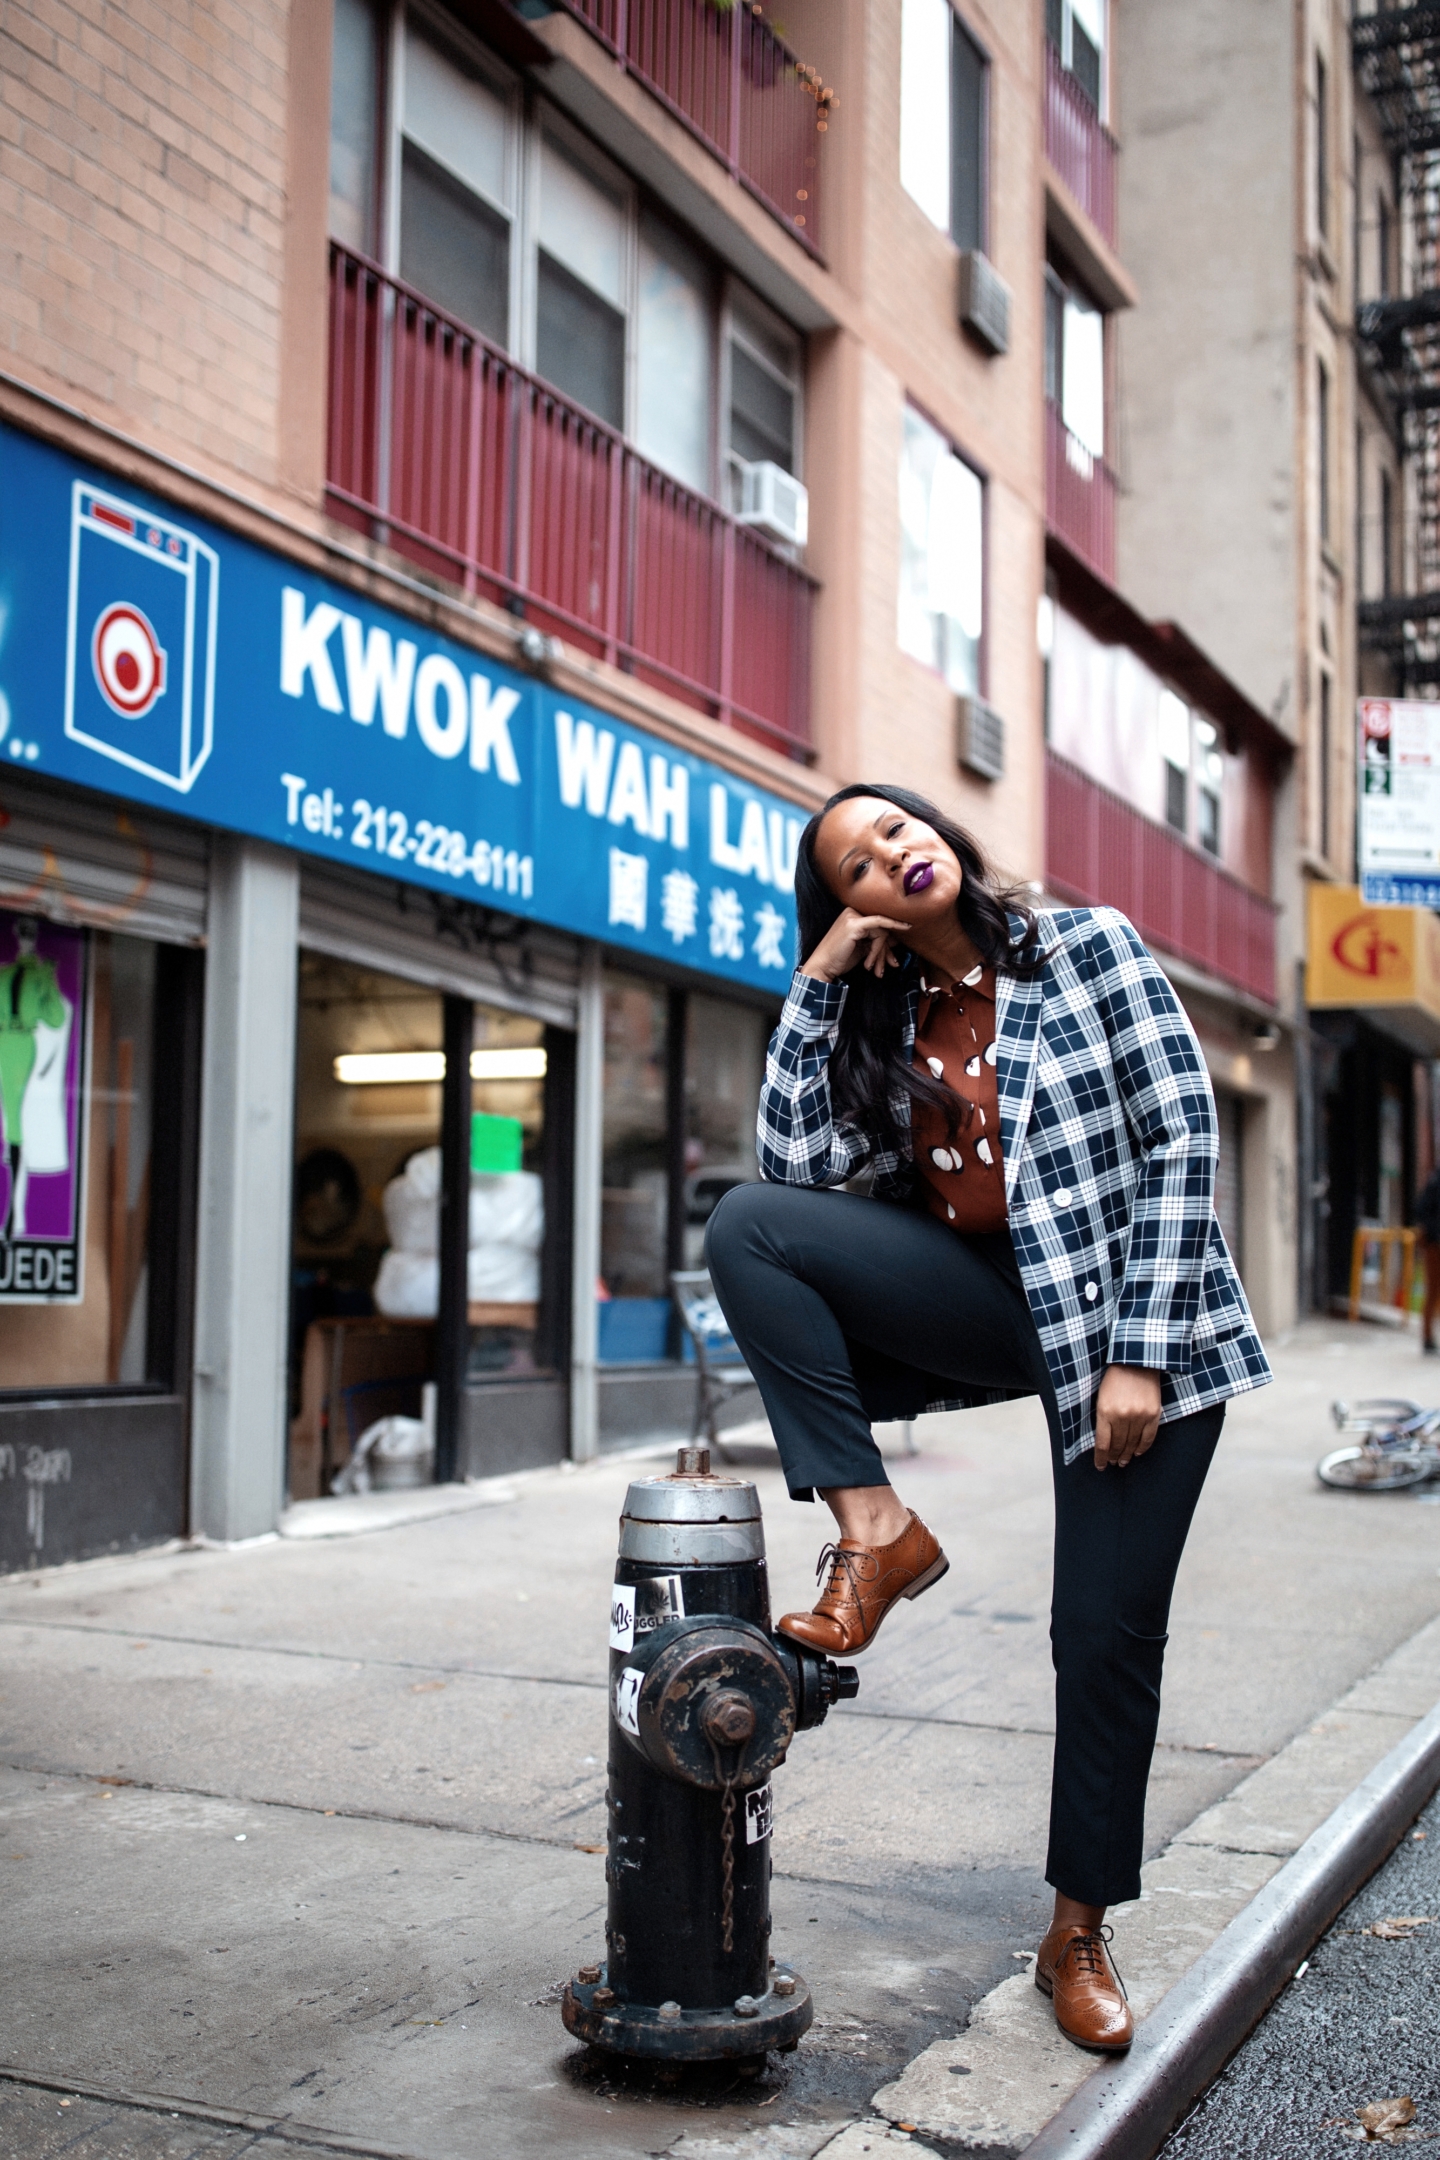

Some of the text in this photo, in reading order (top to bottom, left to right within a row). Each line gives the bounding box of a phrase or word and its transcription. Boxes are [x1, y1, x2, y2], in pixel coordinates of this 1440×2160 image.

[279, 585, 521, 786] KWOK
[554, 710, 689, 850] WAH
[280, 772, 534, 900] Tel: 212-228-6111
